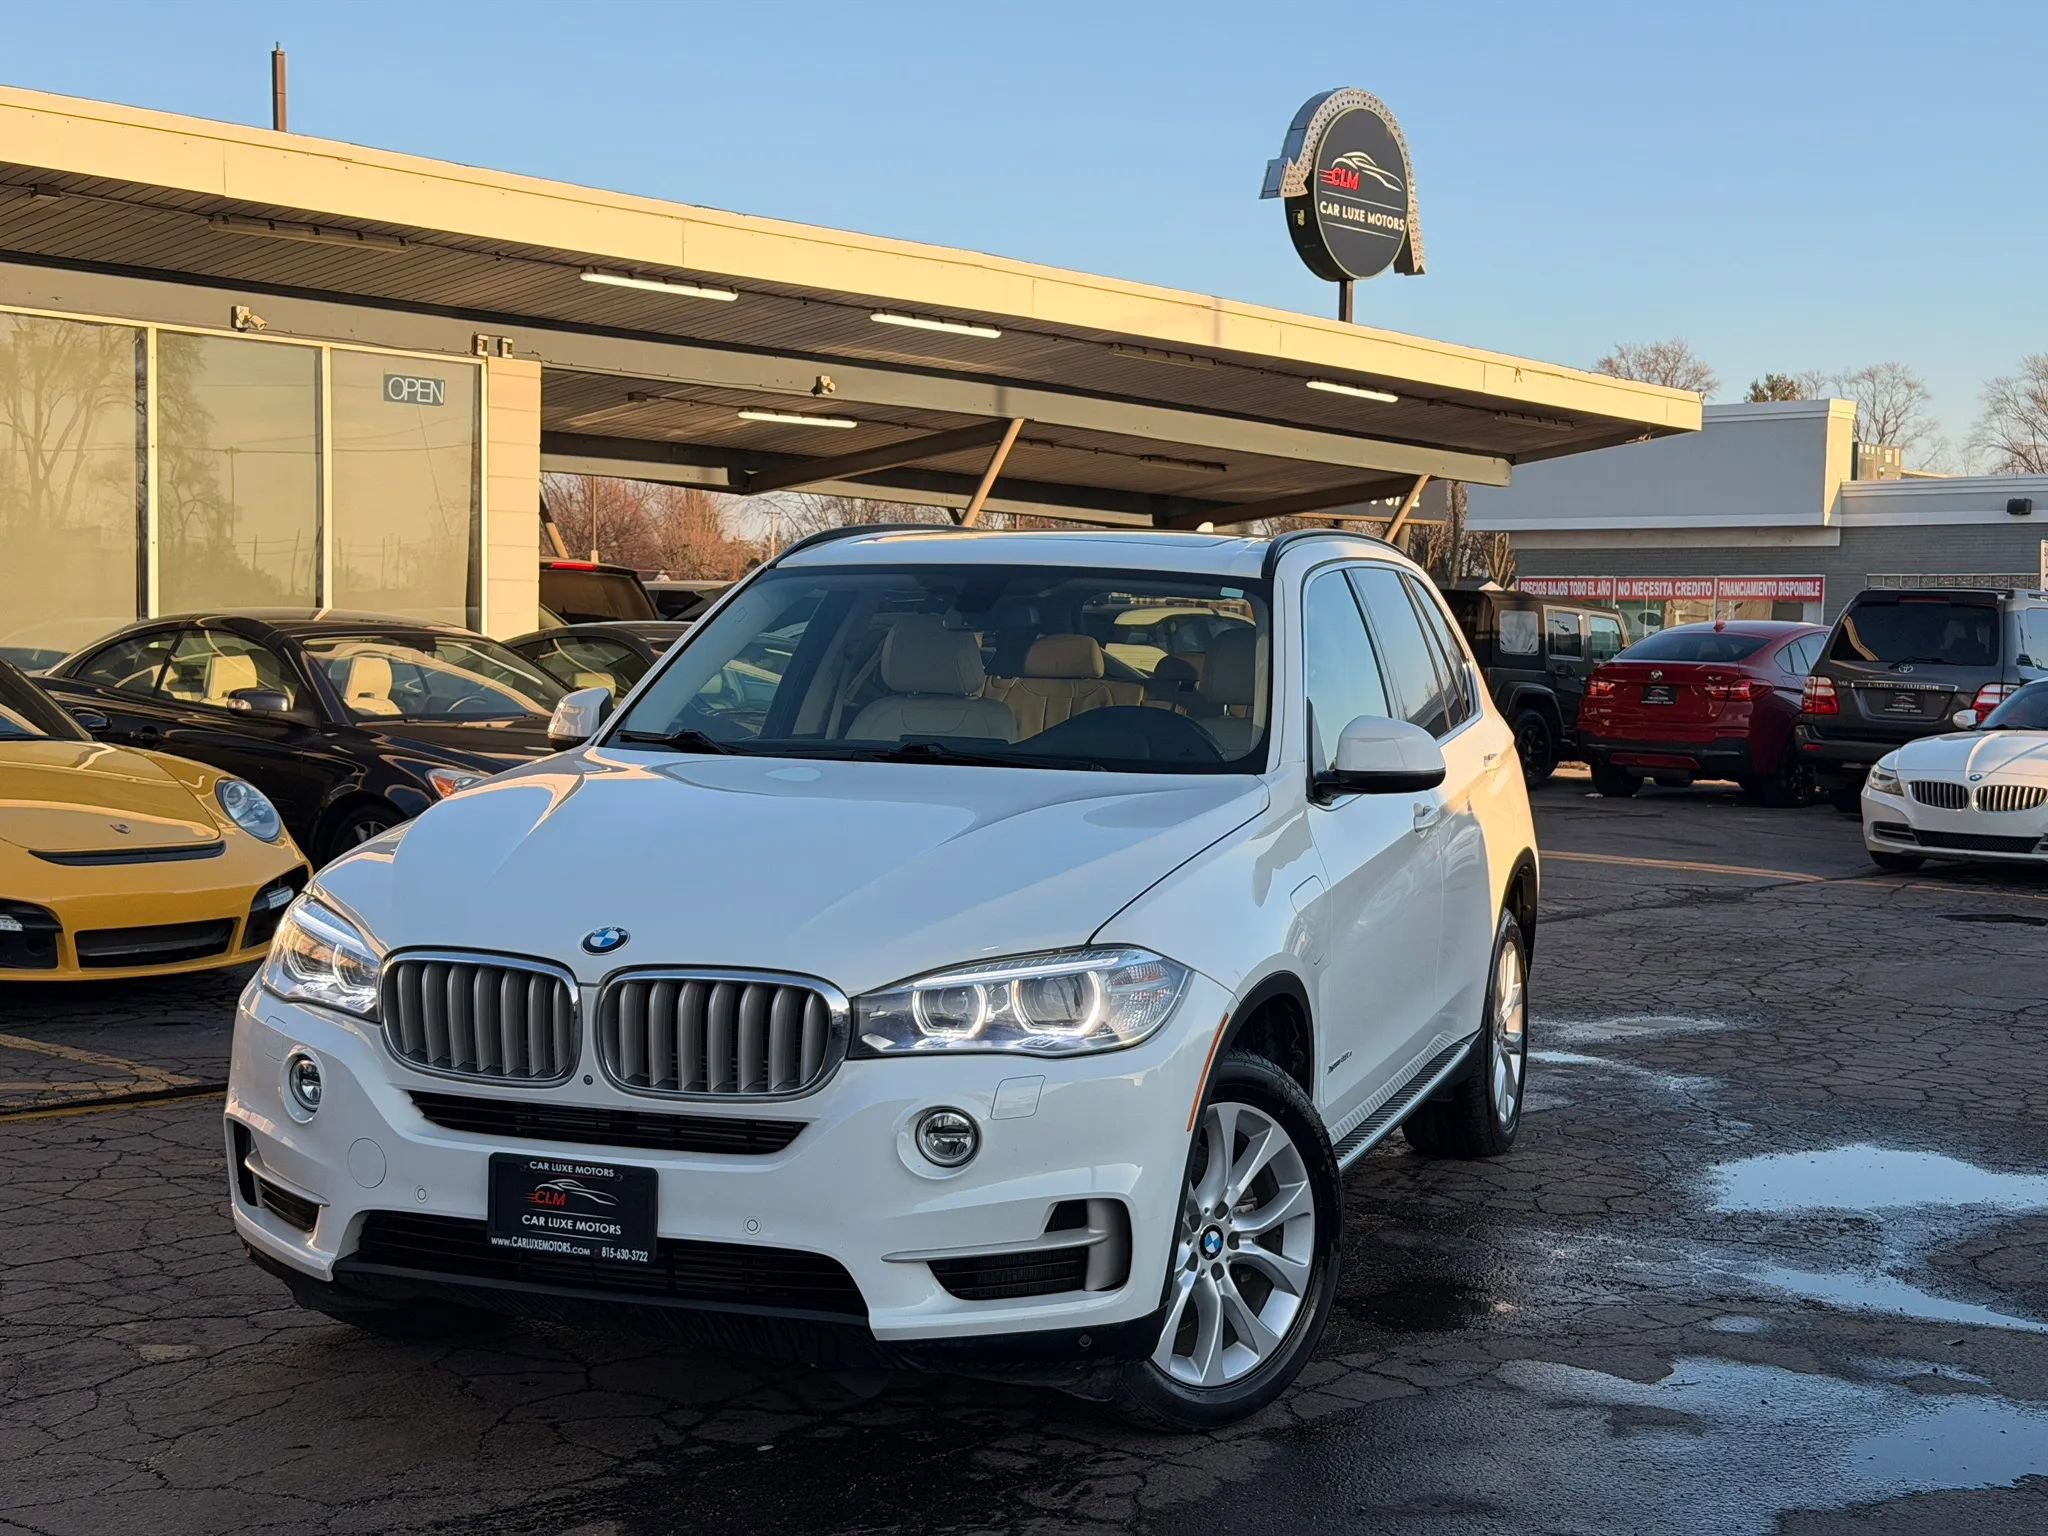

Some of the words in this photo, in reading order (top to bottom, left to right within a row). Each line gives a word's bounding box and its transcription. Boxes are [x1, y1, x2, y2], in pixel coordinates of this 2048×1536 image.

[1331, 167, 1360, 191] CLM
[1319, 201, 1340, 217] CAR
[1342, 205, 1366, 222] LUXE
[1367, 212, 1405, 231] MOTORS
[388, 377, 445, 404] OPEN
[1520, 581, 1547, 596] PRECIOS
[1548, 581, 1569, 596] BAJOS
[1569, 581, 1587, 596] TODO
[1587, 581, 1596, 596] EL
[1596, 579, 1611, 597] AÑO
[1617, 581, 1630, 596] NO
[1631, 581, 1673, 596] NECESITA
[1674, 581, 1713, 597] CREDITO
[1719, 581, 1777, 597] FINANCIAMIENTO
[1778, 581, 1821, 597] DISPONIBLE
[529, 1160, 550, 1172] CAR
[551, 1163, 573, 1174] LUXE
[574, 1165, 615, 1178] MOTORS
[535, 1190, 567, 1206] CLM
[521, 1214, 546, 1227] CAR
[548, 1217, 573, 1230] LUXE
[575, 1221, 622, 1236] MOTORS
[601, 1246, 648, 1262] 815-630-3722
